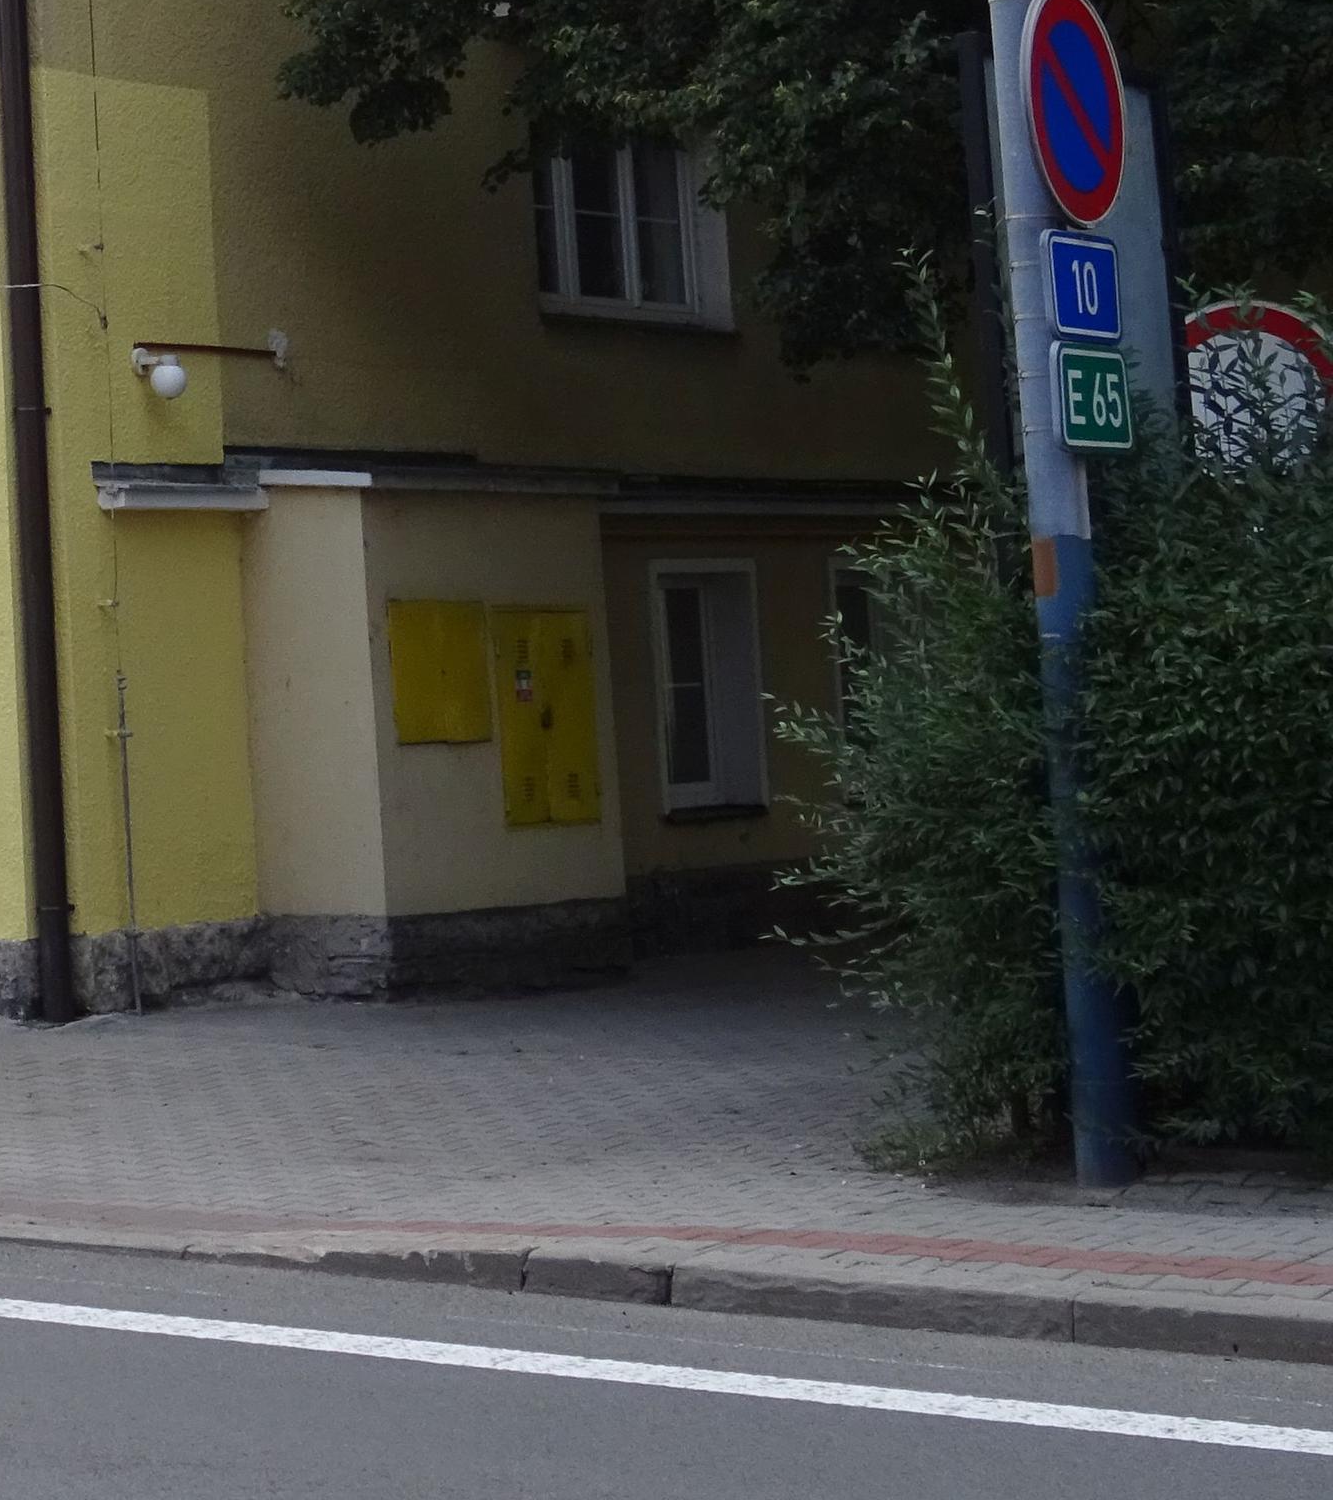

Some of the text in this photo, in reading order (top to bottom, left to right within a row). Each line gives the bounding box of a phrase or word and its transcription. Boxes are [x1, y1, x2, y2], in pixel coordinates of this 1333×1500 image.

[1071, 259, 1099, 316] 10
[1066, 368, 1123, 429] E 65
